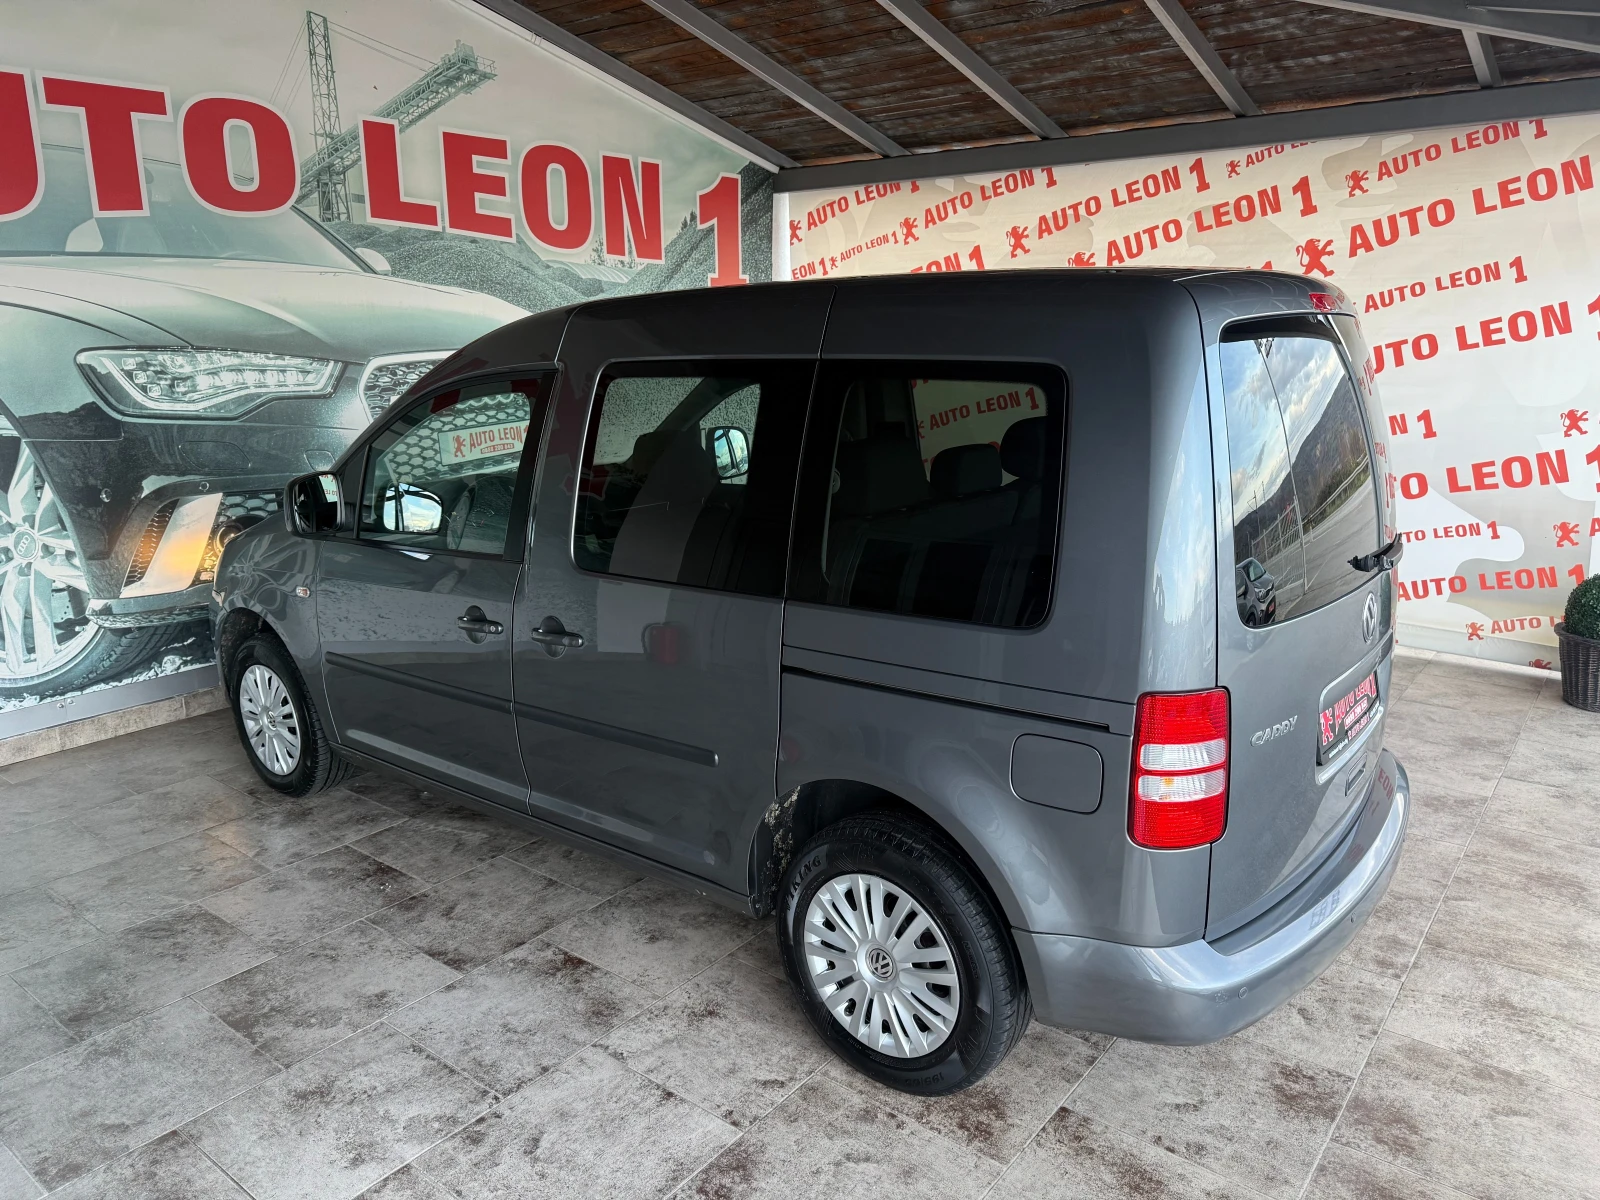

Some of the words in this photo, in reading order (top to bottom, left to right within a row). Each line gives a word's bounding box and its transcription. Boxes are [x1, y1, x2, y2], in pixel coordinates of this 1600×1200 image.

[1245, 144, 1285, 168] AUTO
[1376, 143, 1443, 182] AUTO
[1450, 121, 1521, 155] LEON
[1528, 118, 1549, 140] 1
[361, 119, 663, 261] LEON
[697, 175, 748, 288] 1
[806, 195, 850, 232] AUTO
[923, 190, 974, 230] AUTO
[979, 168, 1036, 203] LEON
[1040, 166, 1058, 190] 1
[1036, 195, 1103, 241] AUTO
[1109, 165, 1183, 209] LEON
[1188, 157, 1211, 194] 1
[1348, 197, 1456, 259] AUTO
[1471, 154, 1595, 216] LEON
[1105, 218, 1184, 268] AUTO
[1193, 184, 1283, 234] LEON
[1291, 175, 1319, 218] 1
[839, 244, 864, 263] AUTO
[865, 233, 891, 251] LEON
[890, 230, 900, 245] 1
[967, 243, 986, 272] 1
[791, 261, 817, 281] EON
[818, 257, 829, 277] 1
[1364, 281, 1427, 314] AUTO
[1434, 260, 1502, 292] LEON
[1508, 255, 1529, 284] 1
[1454, 300, 1573, 352] LEON
[929, 404, 971, 431] AUTO
[975, 390, 1022, 415] LEON
[1024, 386, 1040, 411] 1
[1416, 409, 1438, 440] 1
[469, 429, 496, 454] AUTO
[497, 425, 524, 444] LEON
[1445, 448, 1570, 494] LEON
[1432, 522, 1482, 539] LEON
[1486, 520, 1501, 541] 1
[1397, 575, 1468, 602] AUTO
[1477, 565, 1559, 591] LEON
[1490, 617, 1542, 635] AUTO
[1250, 714, 1298, 747] CADDY
